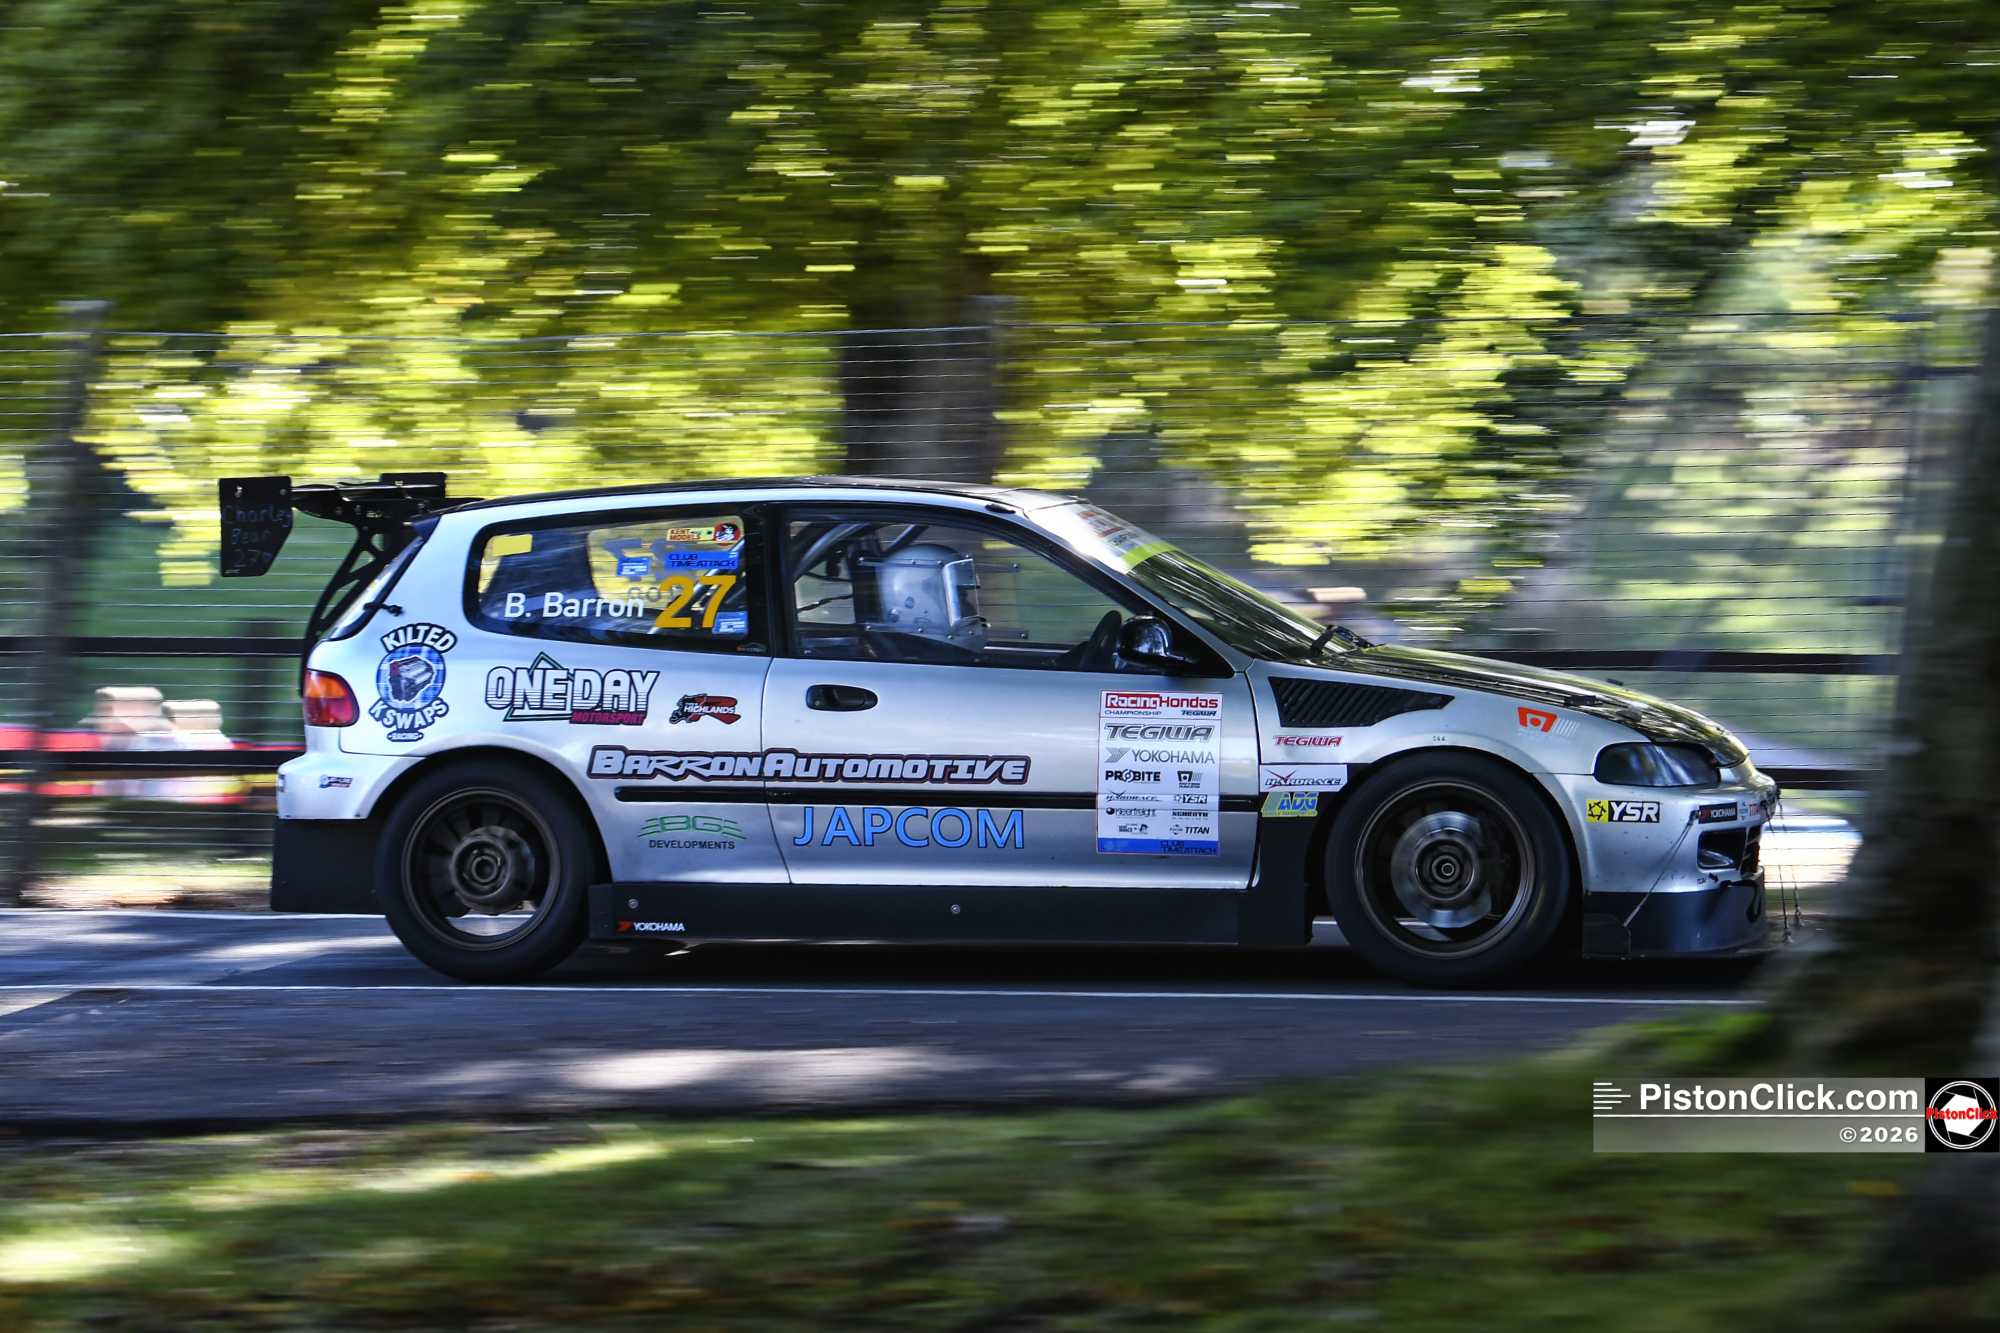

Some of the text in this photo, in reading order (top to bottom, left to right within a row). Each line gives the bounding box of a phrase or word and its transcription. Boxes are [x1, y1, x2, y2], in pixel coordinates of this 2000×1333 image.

[504, 593, 532, 617] B.
[543, 592, 644, 618] Barron
[654, 575, 737, 628] 27
[381, 624, 456, 652] KILTED
[371, 699, 449, 730] K SWAPS
[684, 705, 736, 714] HIGHLANDS
[572, 712, 646, 725] MOTORSPORT
[1104, 723, 1215, 743] TEGIWA
[1273, 735, 1343, 747] TEGIWA
[1132, 749, 1216, 764] YOKOHAMA
[1105, 769, 1161, 783] PROBITE
[1265, 778, 1342, 786] HARDRACE
[1184, 795, 1207, 803] YSR
[1278, 792, 1319, 811] ADG
[1609, 801, 1658, 821] YSR
[1710, 807, 1736, 818] YOKOHAMA
[794, 806, 1025, 849] JAPCOM
[649, 839, 736, 850] DEVELOPMENTS
[633, 922, 686, 932] YOKOHAMA
